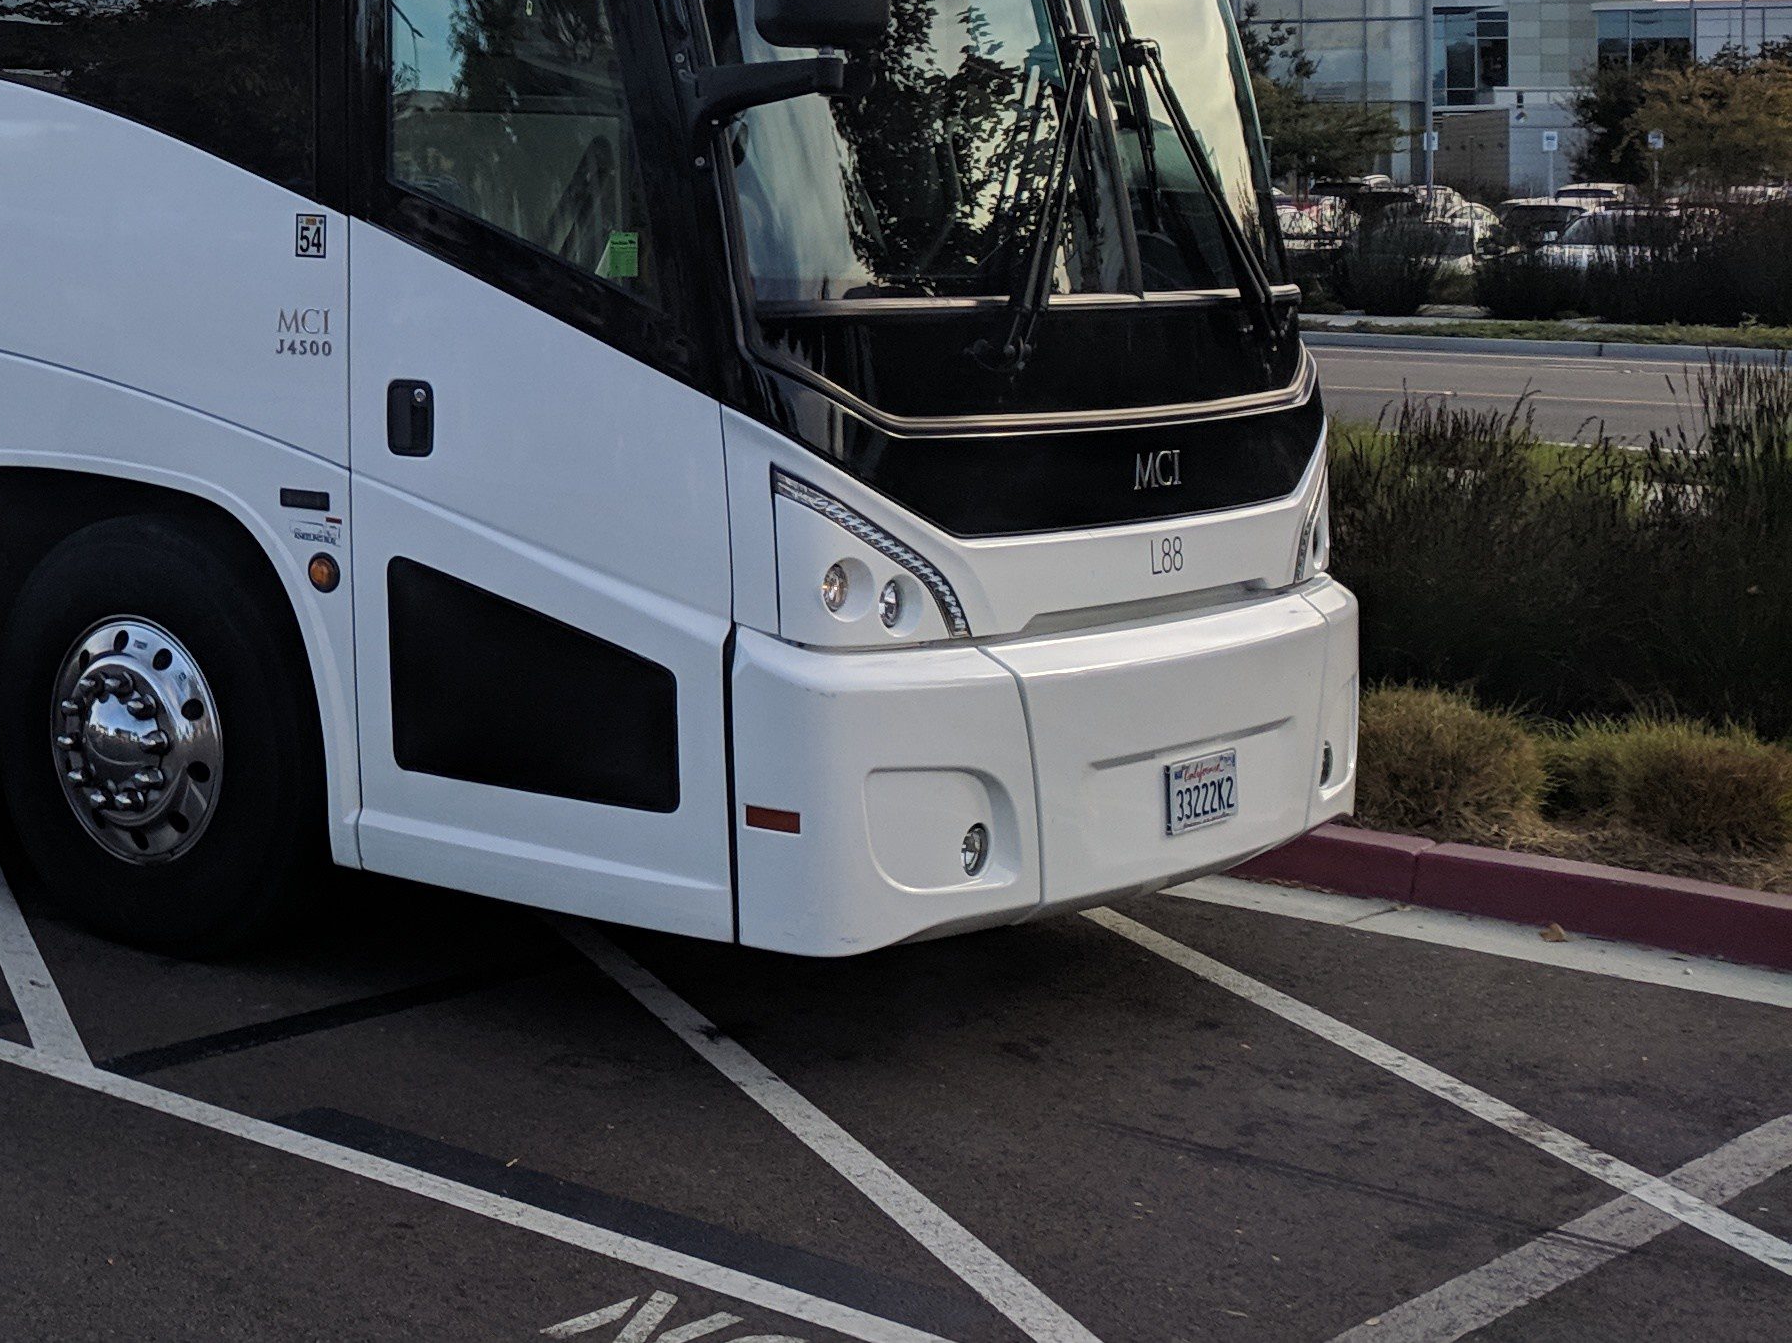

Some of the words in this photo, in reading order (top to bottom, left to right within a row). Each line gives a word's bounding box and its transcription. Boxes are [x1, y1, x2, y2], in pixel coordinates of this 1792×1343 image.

[299, 225, 322, 254] 54
[277, 308, 330, 335] MCI
[275, 339, 332, 357] J4500
[1134, 449, 1182, 491] MCI
[1150, 535, 1184, 575] L88
[1176, 775, 1235, 822] 33222K2
